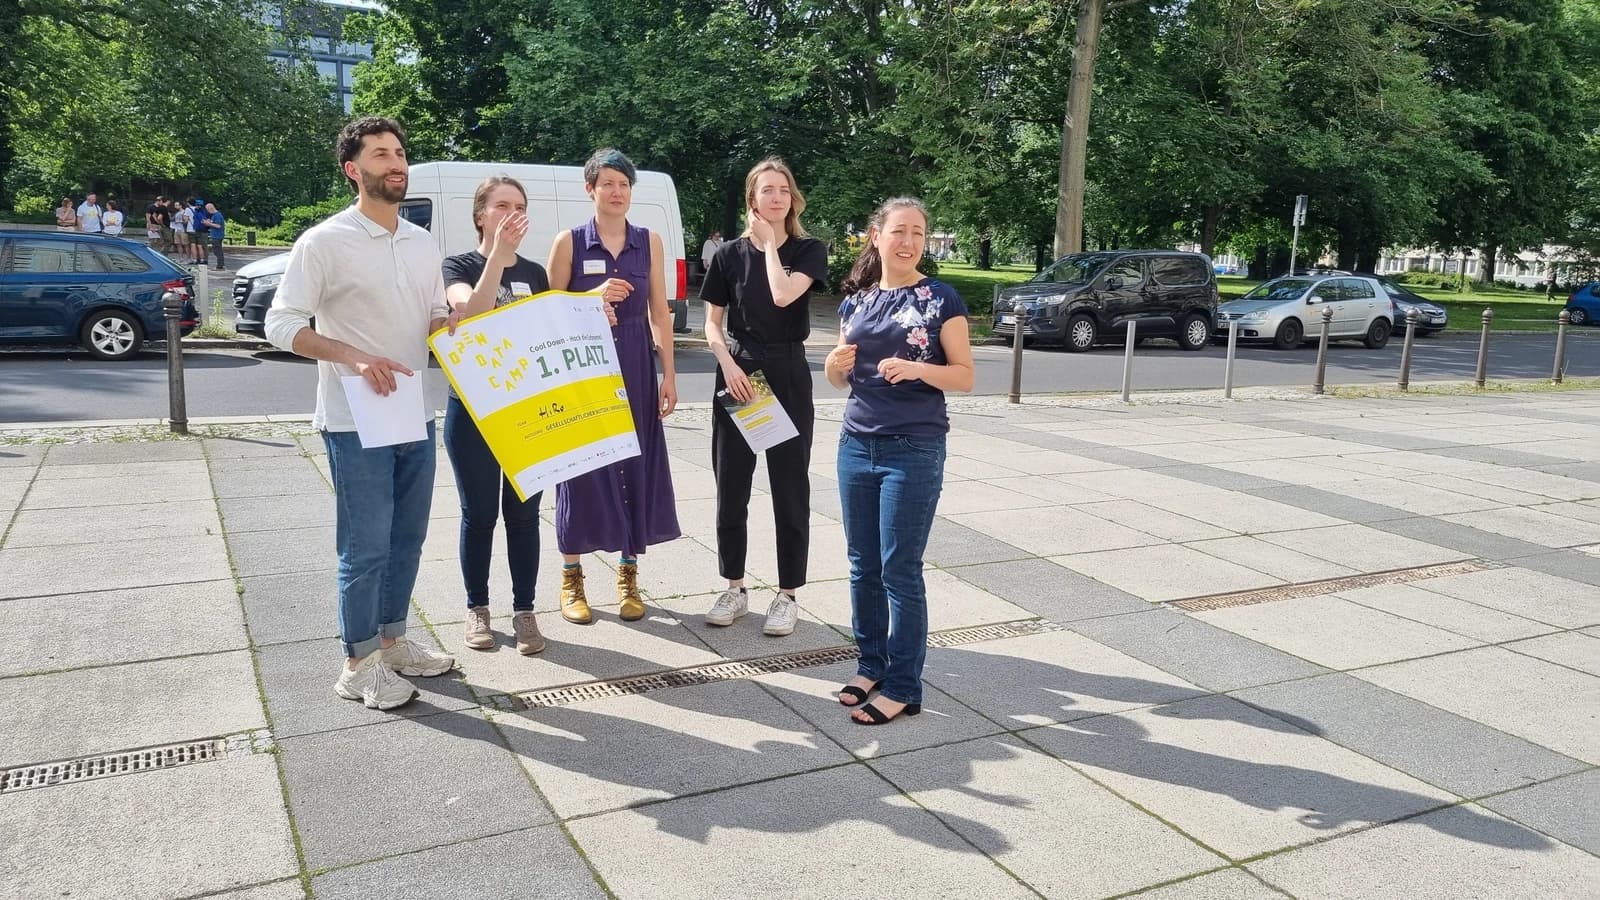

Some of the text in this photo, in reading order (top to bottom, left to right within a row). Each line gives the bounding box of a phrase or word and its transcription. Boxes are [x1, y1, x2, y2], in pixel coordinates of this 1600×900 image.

[475, 337, 513, 368] DATA
[529, 342, 546, 353] Cool
[547, 338, 566, 348] Down
[536, 345, 609, 378] 1. PLATZ
[488, 358, 529, 392] CAMP
